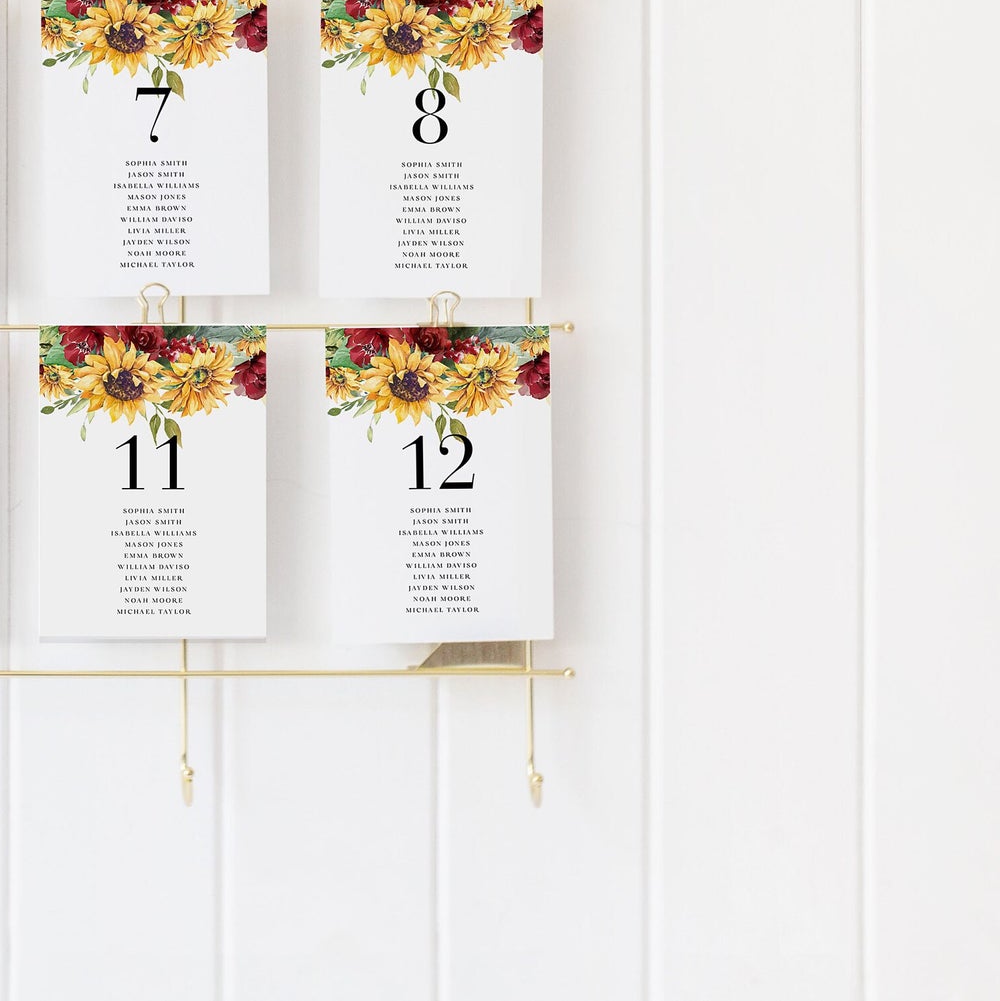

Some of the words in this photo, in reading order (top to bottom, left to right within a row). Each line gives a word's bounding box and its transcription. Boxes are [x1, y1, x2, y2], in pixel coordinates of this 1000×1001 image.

[135, 87, 173, 144] 7
[412, 87, 448, 145] 8
[400, 161, 433, 169] SOPHIA
[127, 171, 155, 179] JASON
[127, 193, 158, 201] MASON
[159, 193, 187, 202] JONES
[402, 228, 426, 236] LIVIA
[428, 228, 461, 236] MILLER
[122, 239, 154, 247] JAYDEN
[156, 238, 191, 246] WILSON
[429, 251, 461, 259] MOORE
[119, 261, 159, 269] MICHAEL
[115, 434, 185, 490] 11
[402, 433, 476, 490] 12
[122, 507, 155, 515] SOPHIA
[157, 507, 185, 515] SMITH
[412, 518, 439, 526] JASON
[444, 540, 471, 548] JONES
[152, 552, 184, 560] BROWN
[408, 584, 439, 593] JAYDEN
[405, 606, 444, 614] MICHAEL
